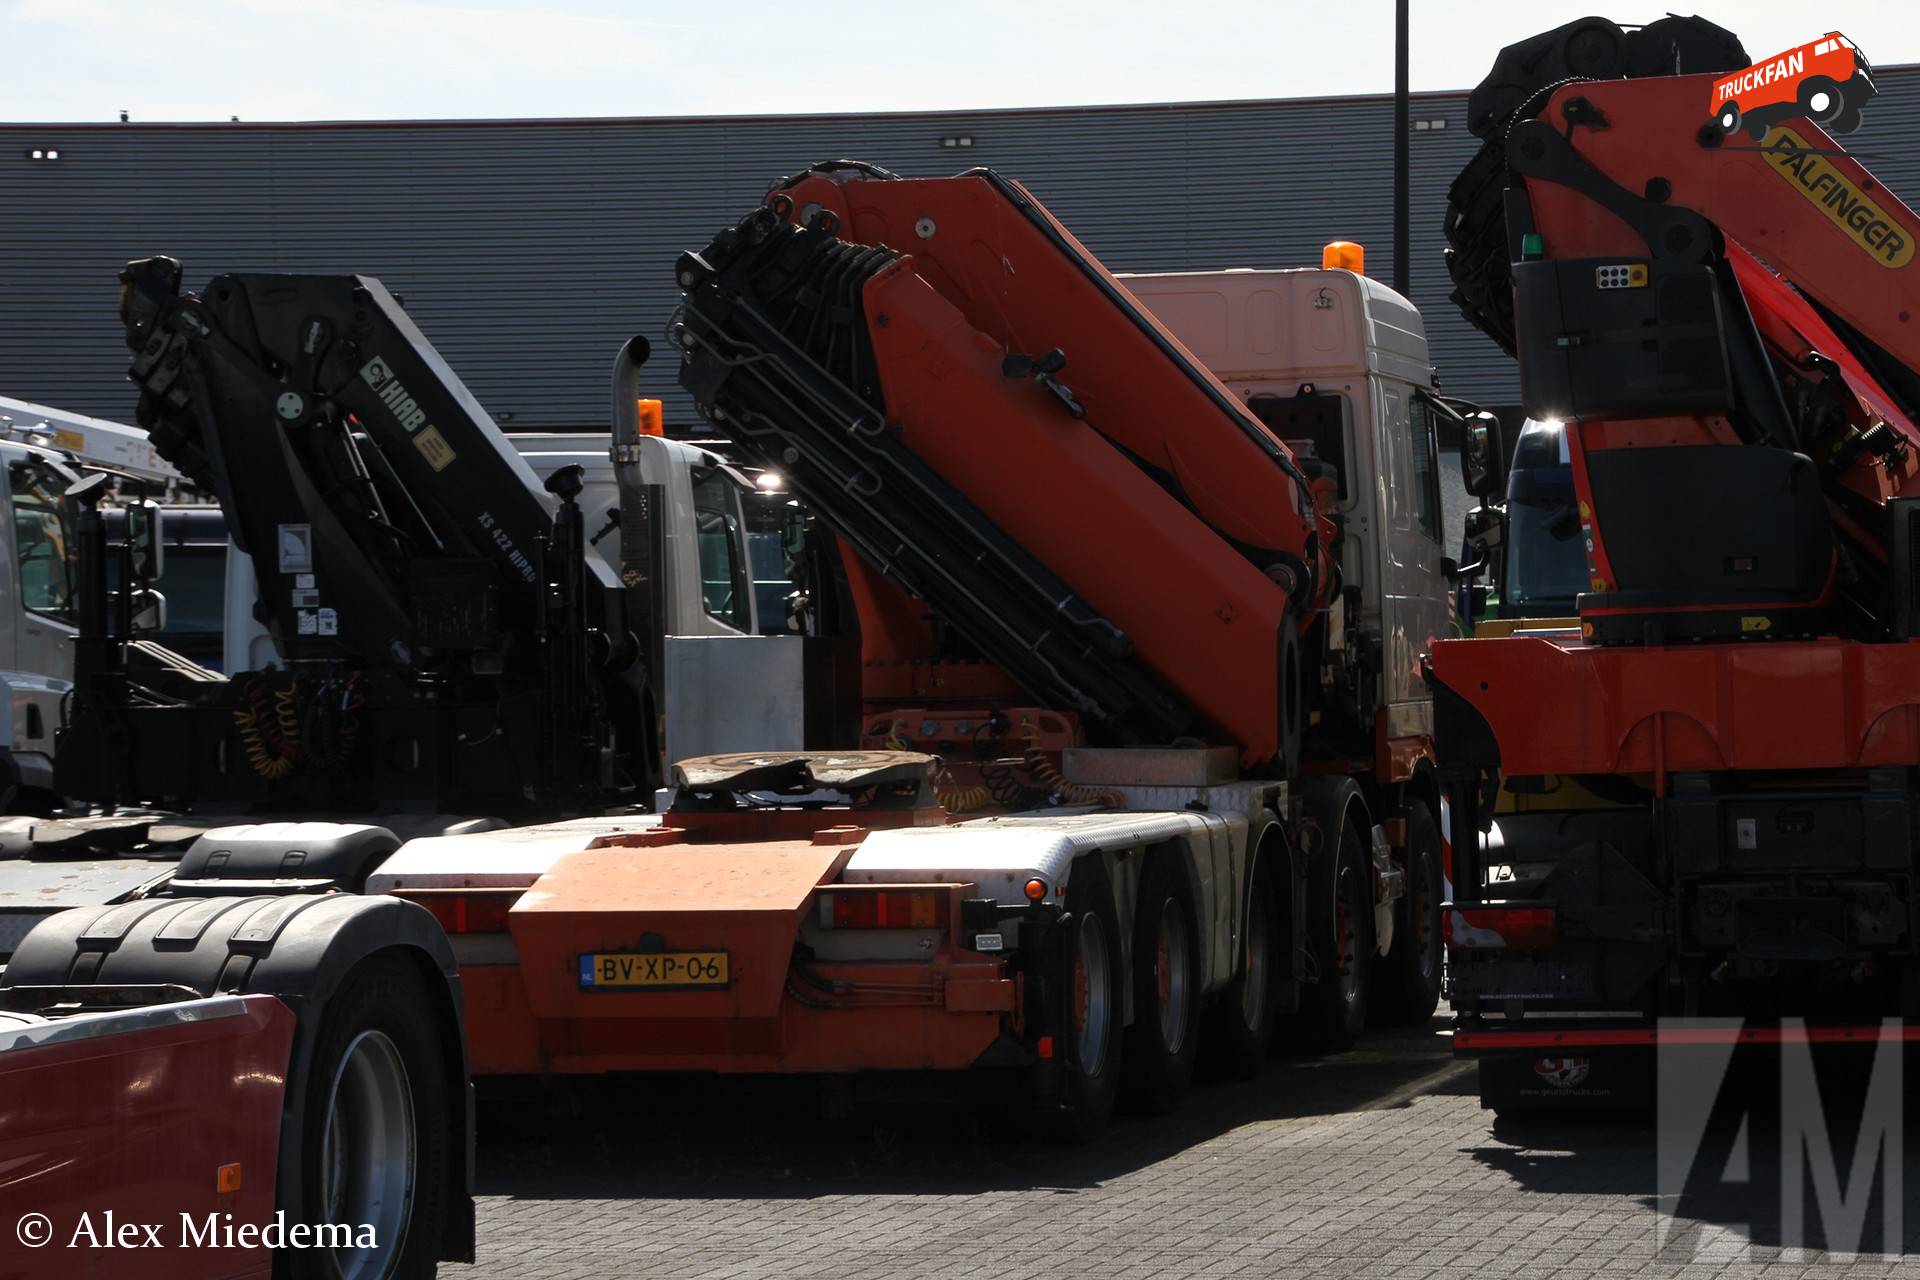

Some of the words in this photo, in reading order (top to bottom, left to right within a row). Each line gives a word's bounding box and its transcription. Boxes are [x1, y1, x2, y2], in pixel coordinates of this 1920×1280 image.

[1769, 134, 1905, 262] PALFINGER
[378, 379, 427, 433] HIAB
[478, 511, 495, 529] XS
[492, 528, 513, 552] 422
[602, 956, 720, 981] BV-XP-06
